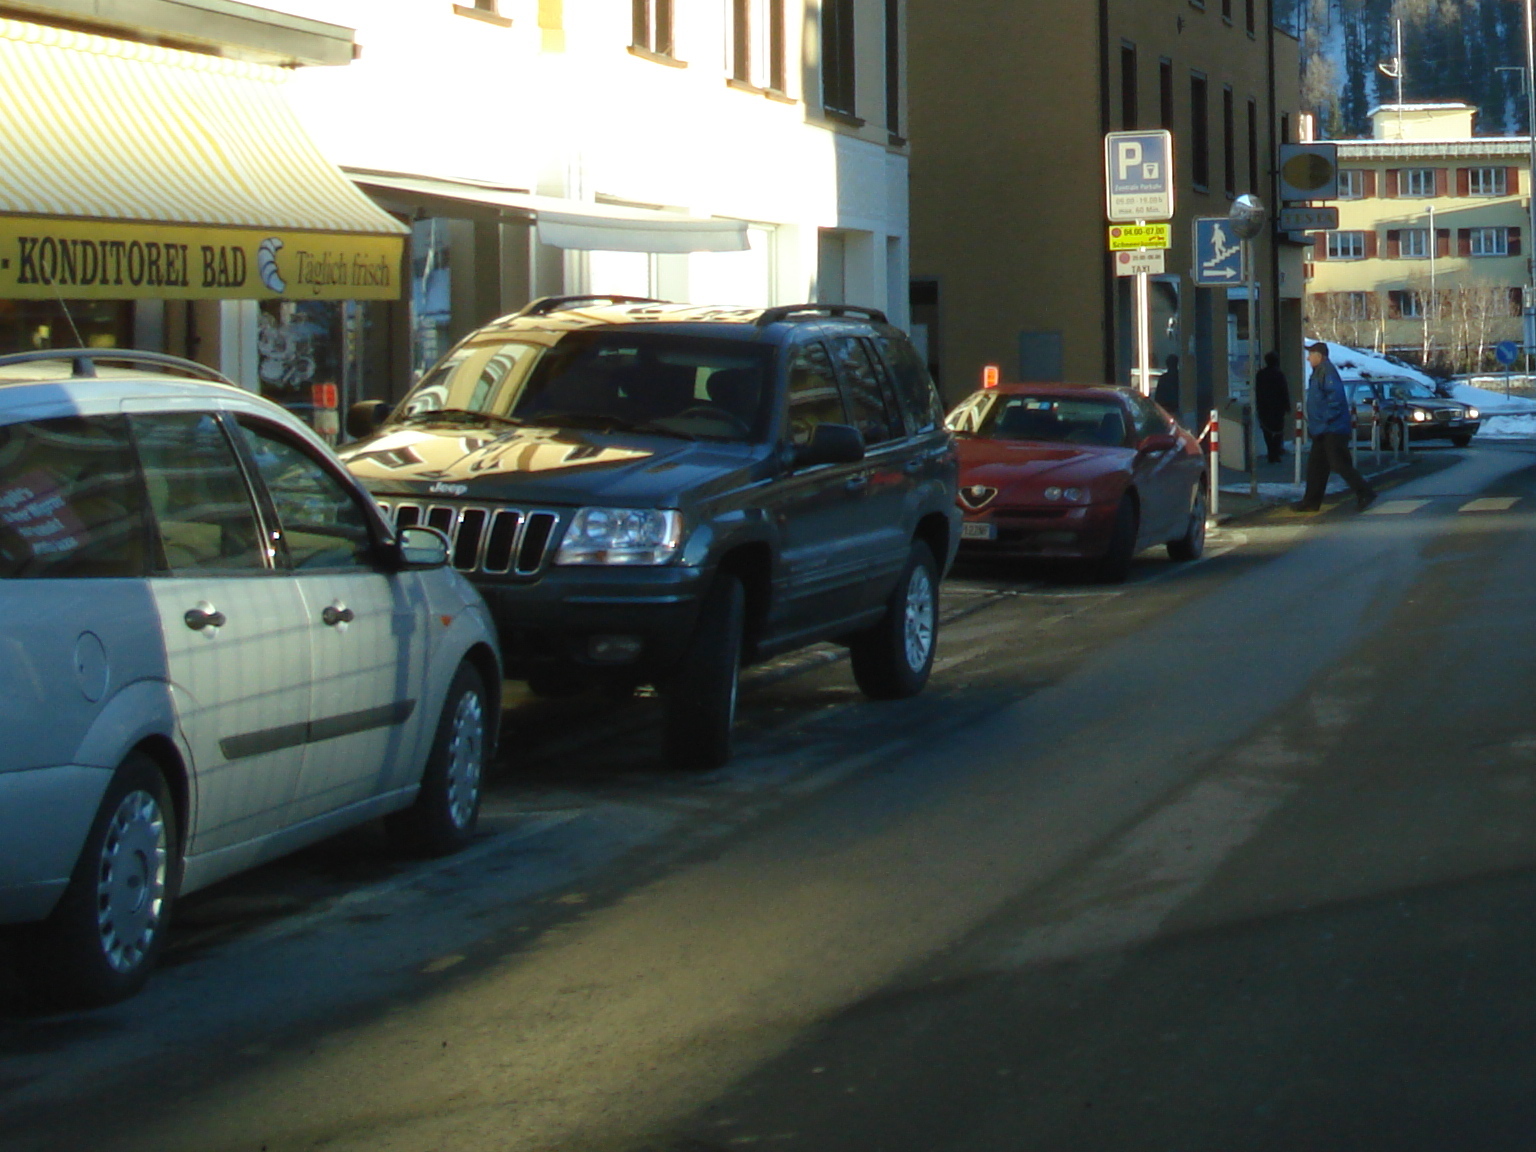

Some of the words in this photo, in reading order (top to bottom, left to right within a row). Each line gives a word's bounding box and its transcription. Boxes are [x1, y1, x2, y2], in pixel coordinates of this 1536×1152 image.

[1118, 141, 1143, 181] P
[17, 236, 190, 287] KONDITOREI
[201, 245, 247, 288] BAD
[296, 250, 348, 295] Täglich
[352, 252, 391, 286] frisch
[429, 482, 469, 497] Jeep
